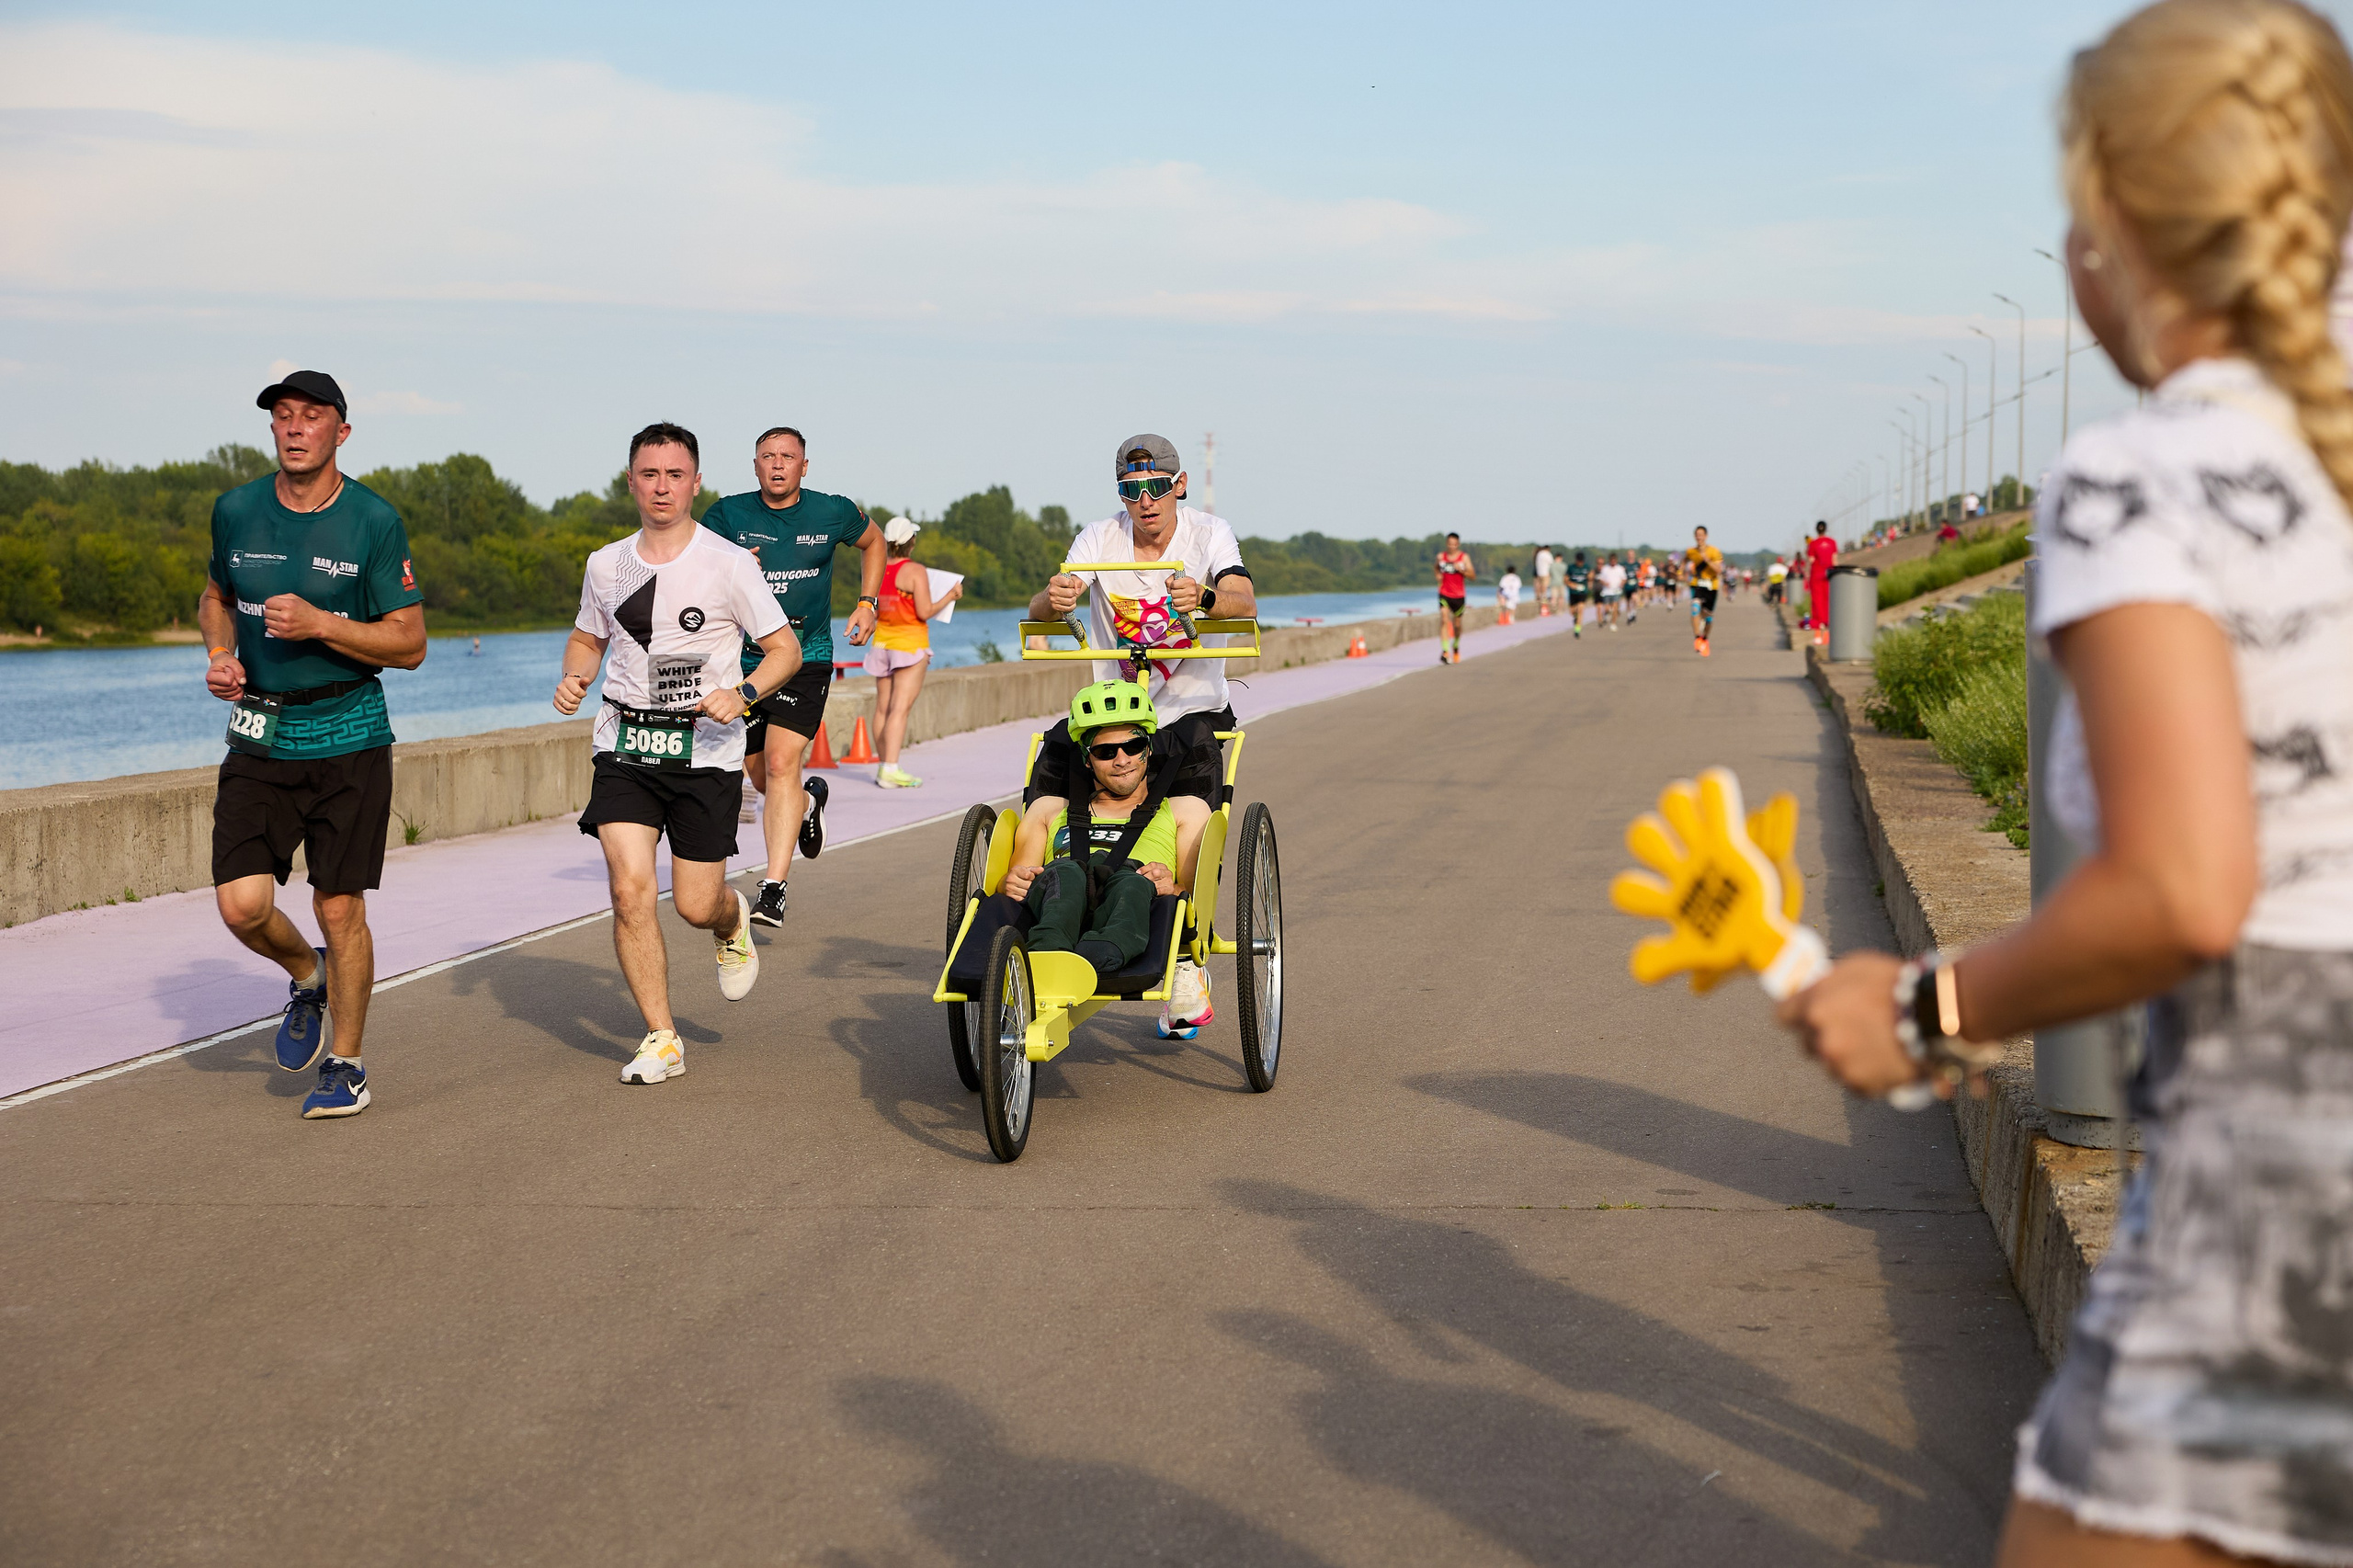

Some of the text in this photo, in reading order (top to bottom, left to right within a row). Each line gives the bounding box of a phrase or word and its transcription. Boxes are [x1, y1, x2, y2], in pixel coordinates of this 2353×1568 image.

[313, 556, 358, 574] MAN STAR
[767, 568, 820, 581] NOVGOROD
[657, 665, 702, 676] WHITE
[658, 677, 701, 689] BRIDE
[659, 690, 702, 703] ULTRA
[625, 726, 683, 756] 5086
[641, 756, 661, 765] ПАВЕЛ
